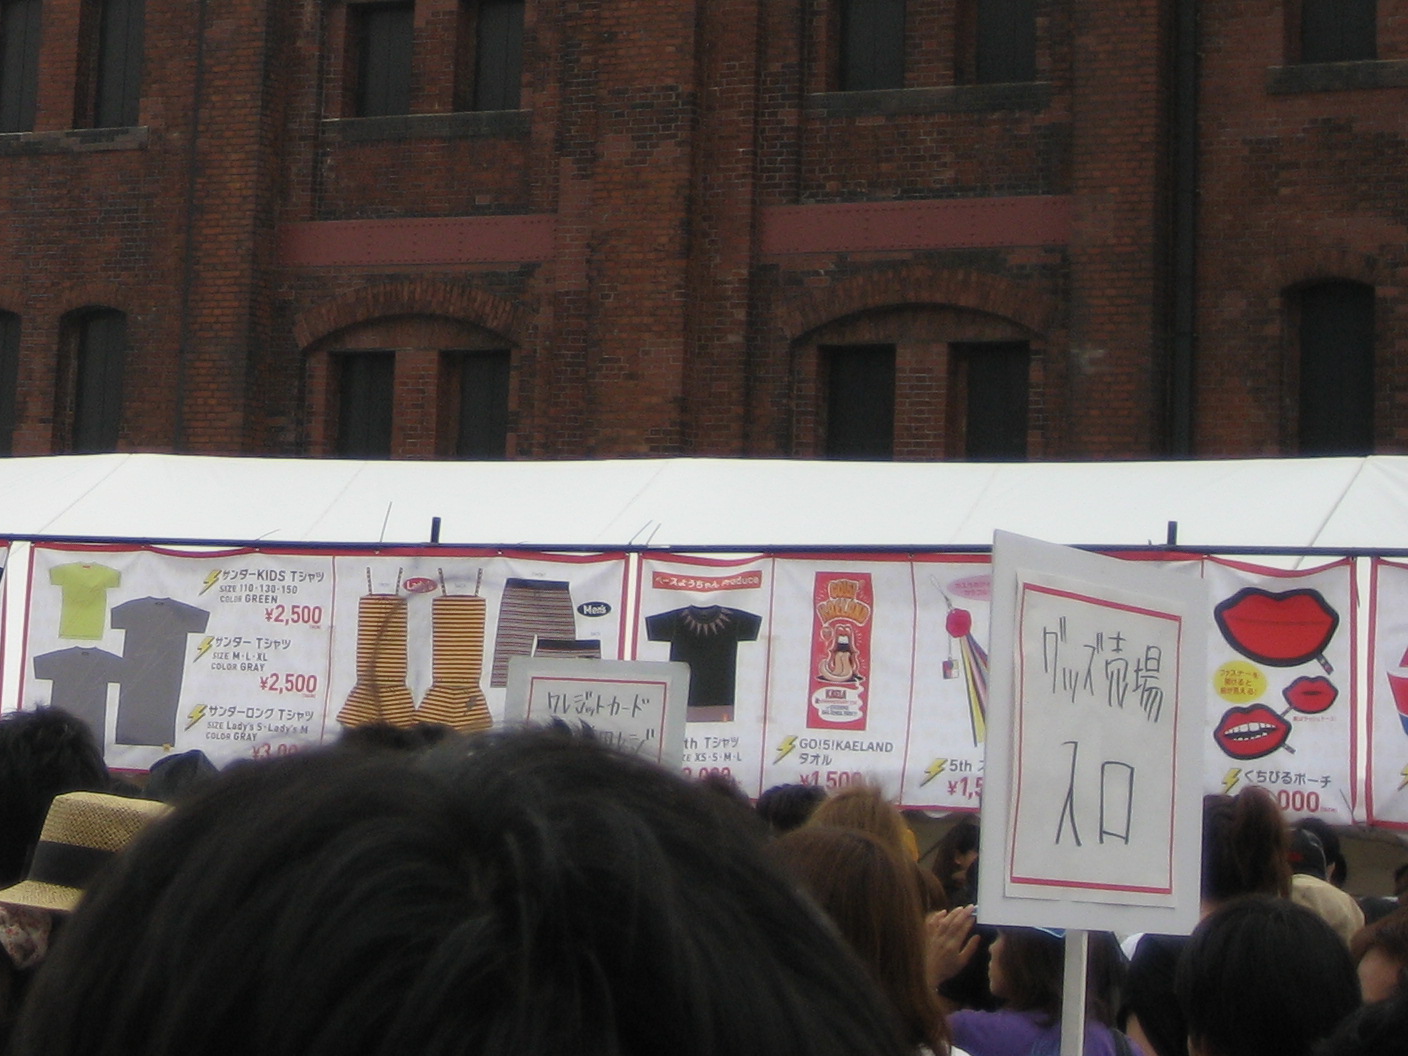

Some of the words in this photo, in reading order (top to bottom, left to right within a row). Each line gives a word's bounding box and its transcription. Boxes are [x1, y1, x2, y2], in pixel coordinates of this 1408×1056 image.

[221, 569, 286, 582] サンダーKIDS
[290, 570, 325, 583] Tシャツ
[219, 585, 237, 593] SIZE
[244, 595, 278, 605] GREEN
[264, 603, 323, 626] ¥2,500
[214, 636, 252, 649] サンダー
[256, 637, 292, 650] Tシャツ
[211, 652, 229, 661] SIZE
[239, 662, 266, 673] GRAY
[1042, 616, 1164, 723] グッズ売場
[259, 672, 319, 695] ¥2,500
[208, 704, 275, 720] サンダーロング
[278, 708, 315, 722] Tシャツ
[233, 731, 258, 742] GRAY
[704, 736, 740, 749] Tシャツ
[799, 738, 894, 753] GO!5!KAELAND
[798, 752, 833, 766] タオル
[949, 759, 973, 772] 5th
[1244, 769, 1332, 789] くちびるポーチ
[1055, 741, 1135, 847] 入口
